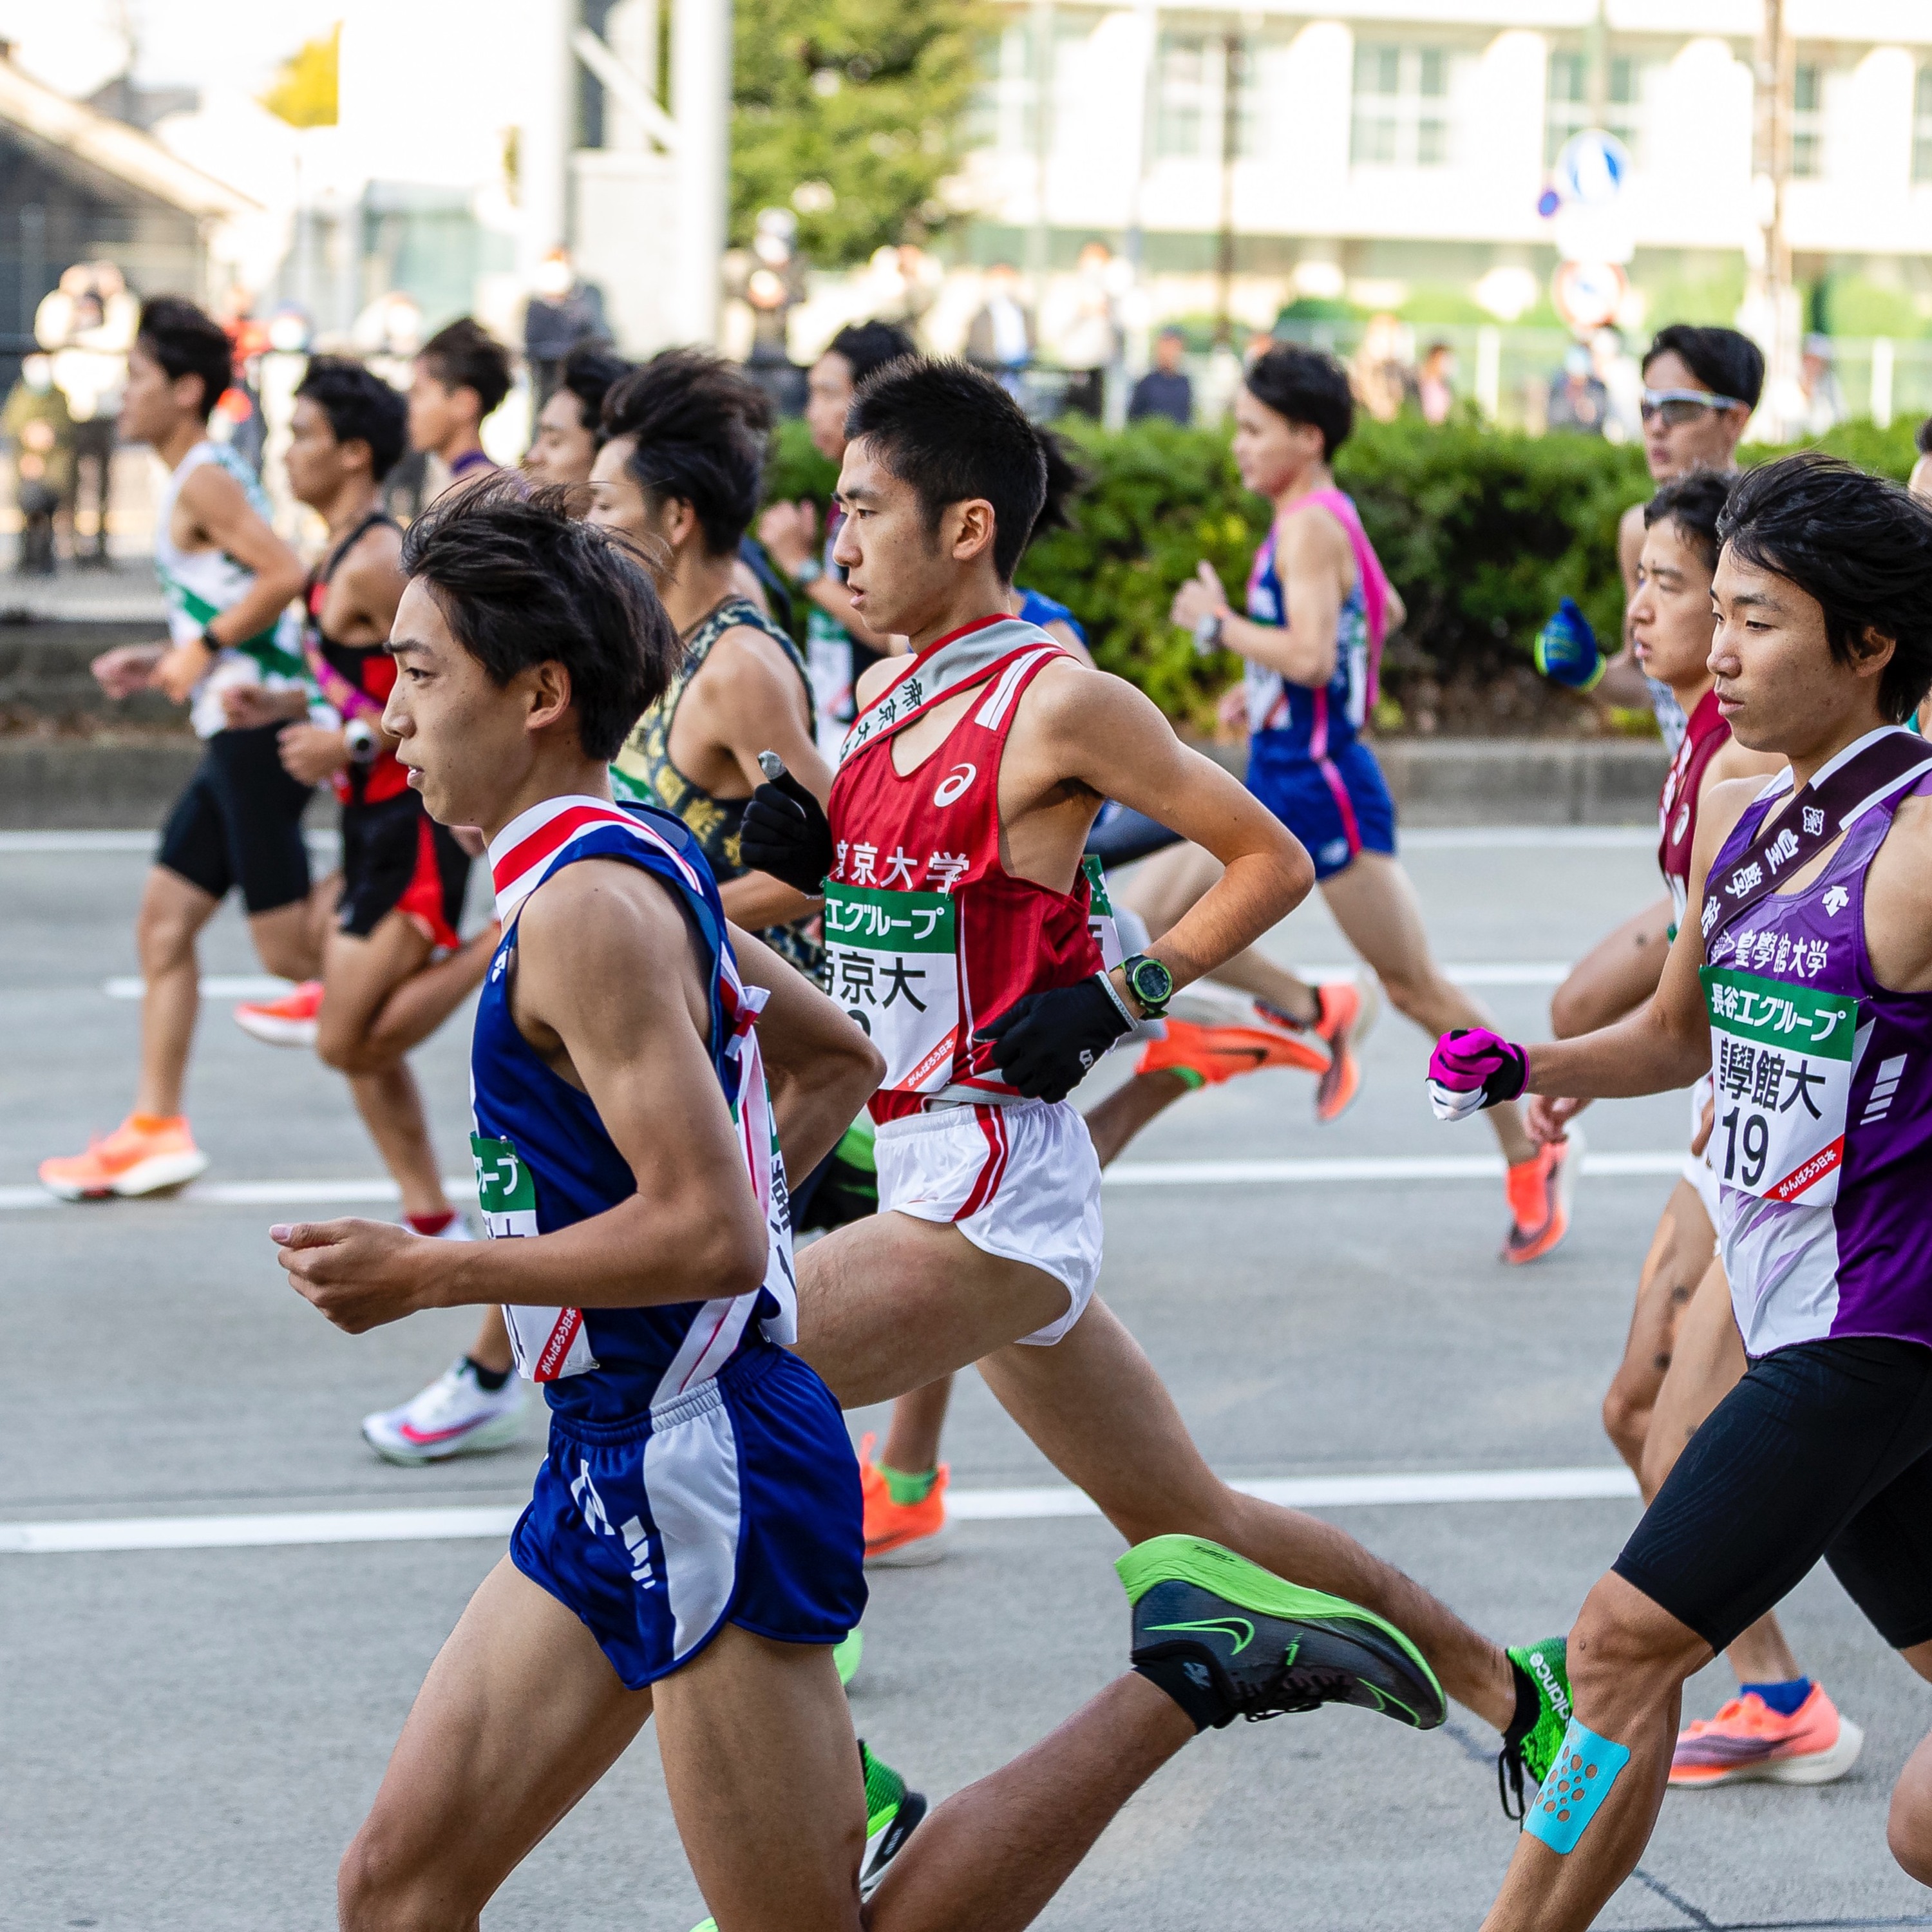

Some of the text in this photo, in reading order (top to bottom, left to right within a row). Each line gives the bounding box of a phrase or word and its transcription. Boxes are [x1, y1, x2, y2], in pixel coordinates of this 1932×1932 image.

[907, 1037, 955, 1088] がんばろう日本
[1721, 1106, 1769, 1188] 19
[1778, 1148, 1837, 1198] がんばろう日本
[1529, 1652, 1570, 1728] alance
